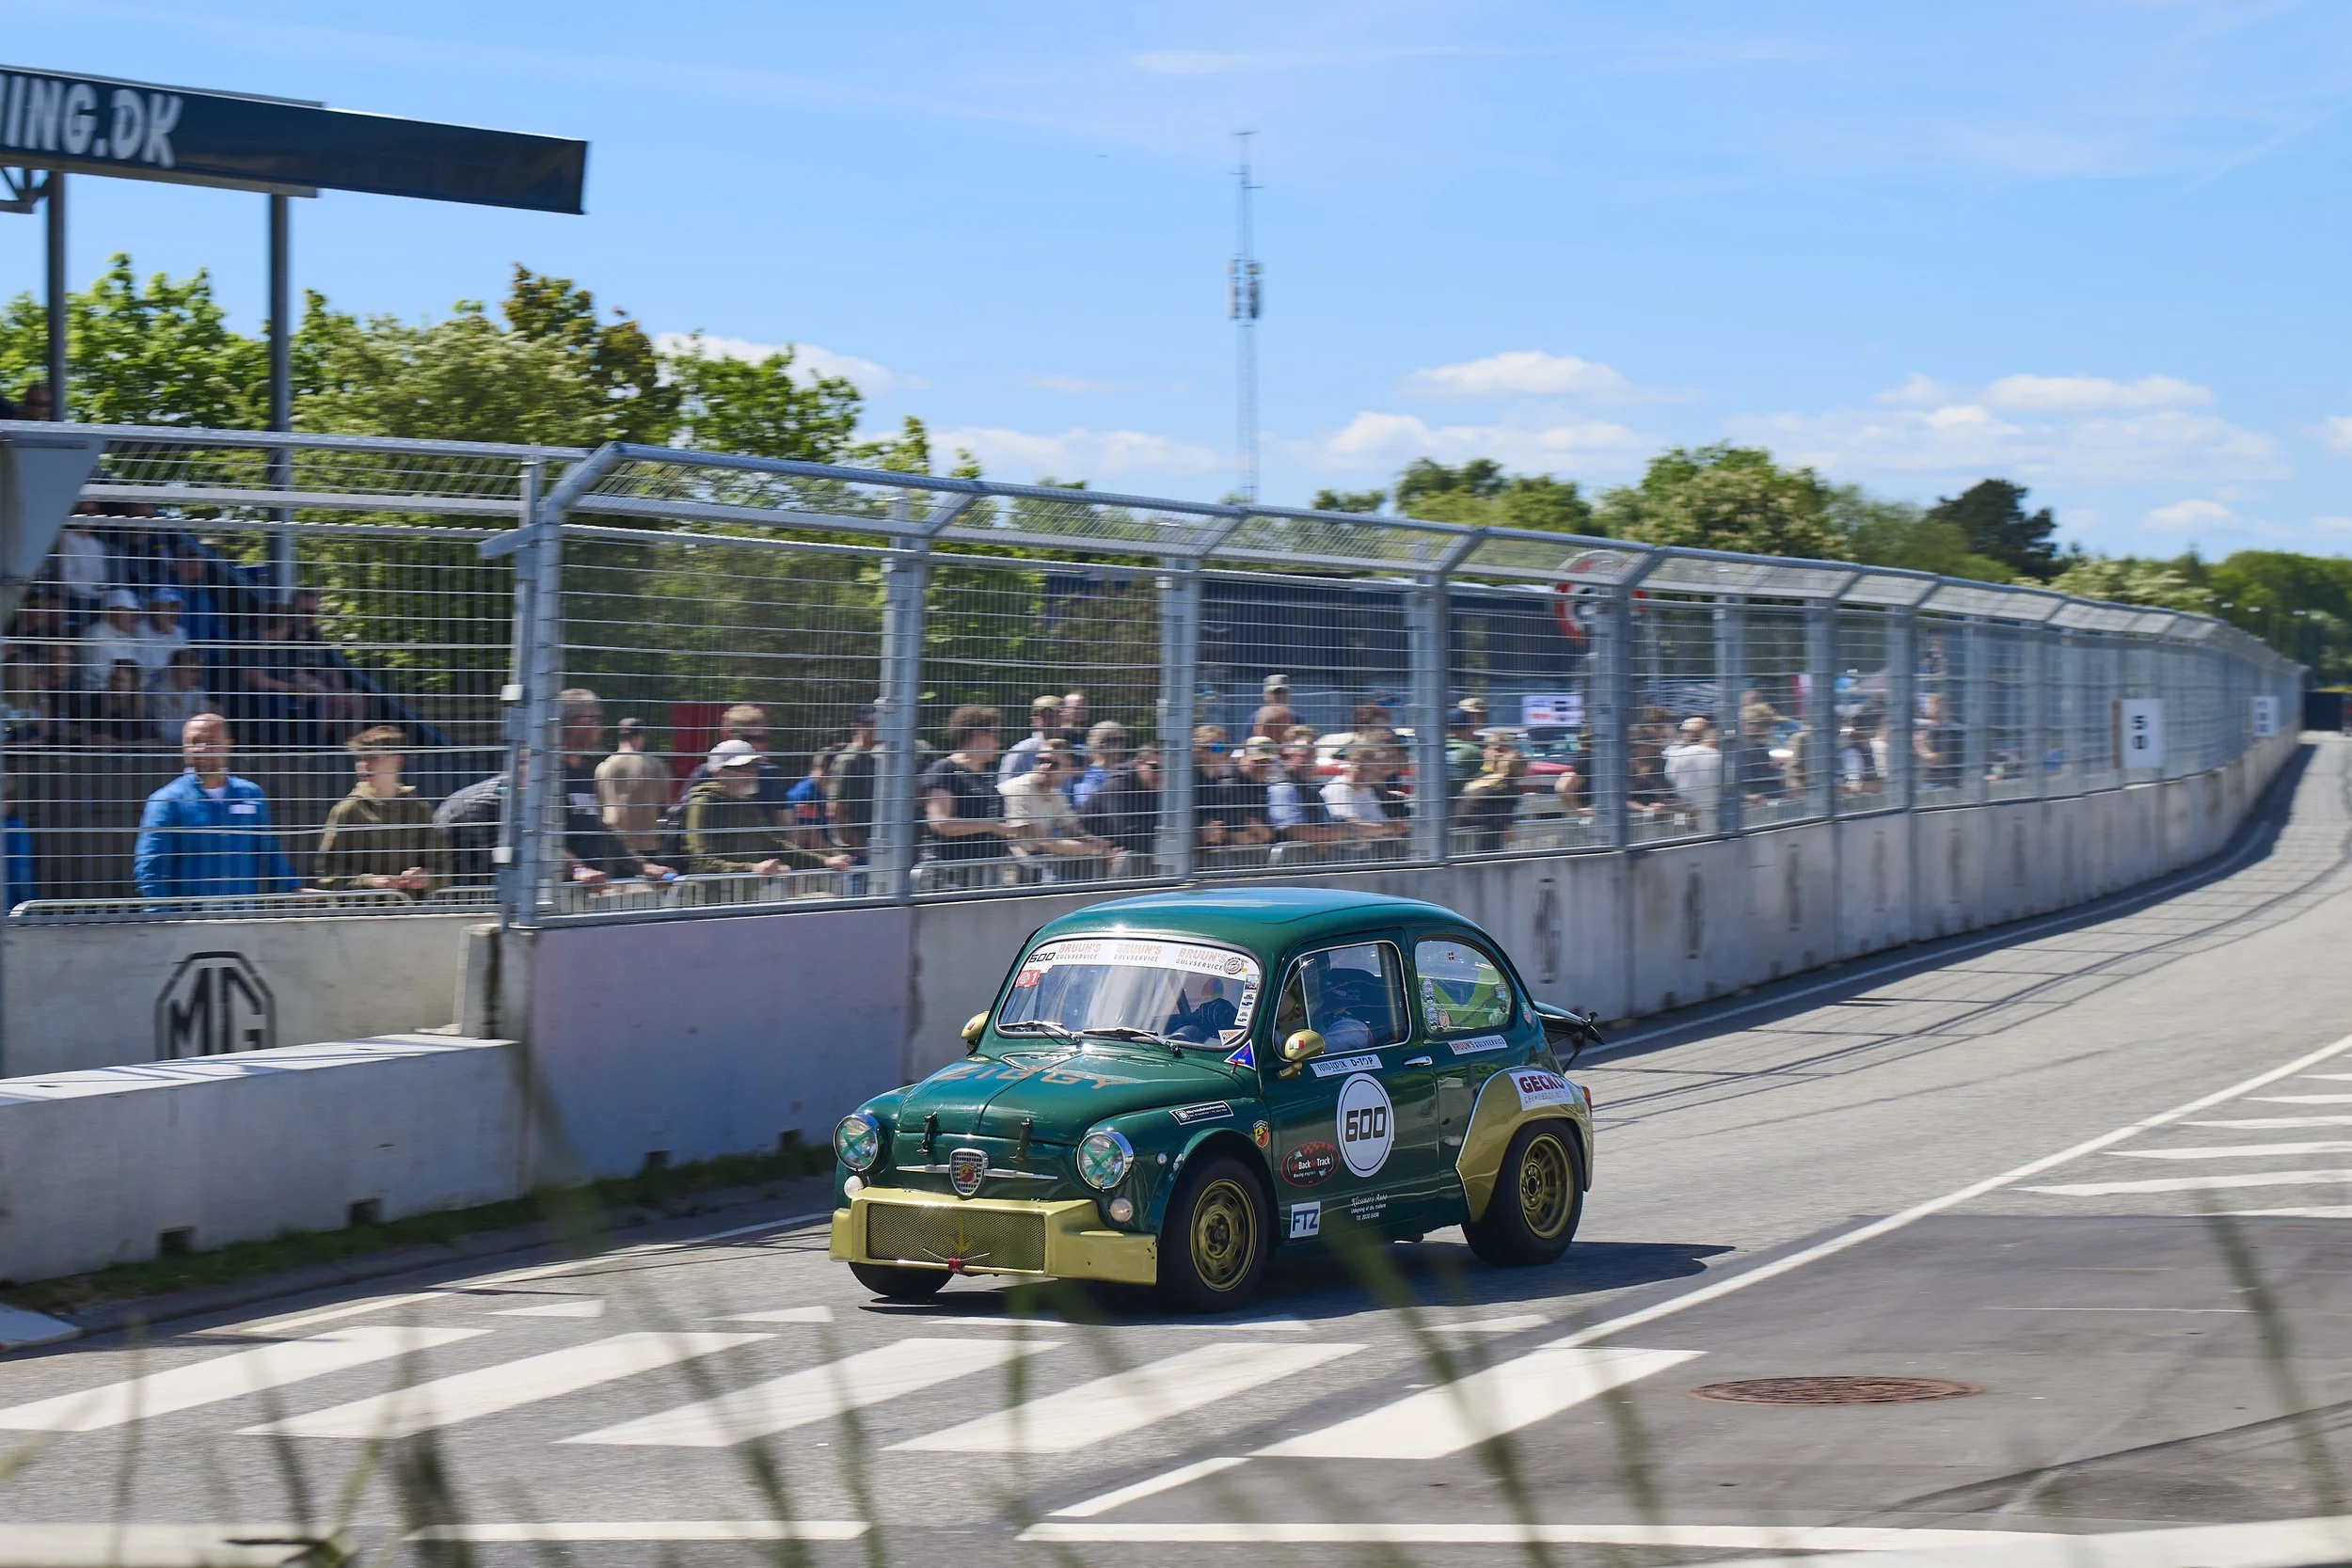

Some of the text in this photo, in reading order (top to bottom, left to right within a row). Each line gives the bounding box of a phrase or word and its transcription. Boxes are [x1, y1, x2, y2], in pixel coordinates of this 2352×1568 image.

[1058, 943, 1102, 953] BRUUN'S
[1117, 943, 1163, 955] BRUUN'S
[1028, 952, 1056, 963] 600
[1113, 954, 1159, 962] GULVSERVICE
[1179, 947, 1228, 963] BRUUN'S
[1175, 958, 1223, 971] GULVSERVICE
[1350, 1056, 1374, 1067] D-TOP
[1518, 1074, 1565, 1094] GECKO
[1345, 1105, 1387, 1143] 600
[1292, 1209, 1319, 1231] FTZ
